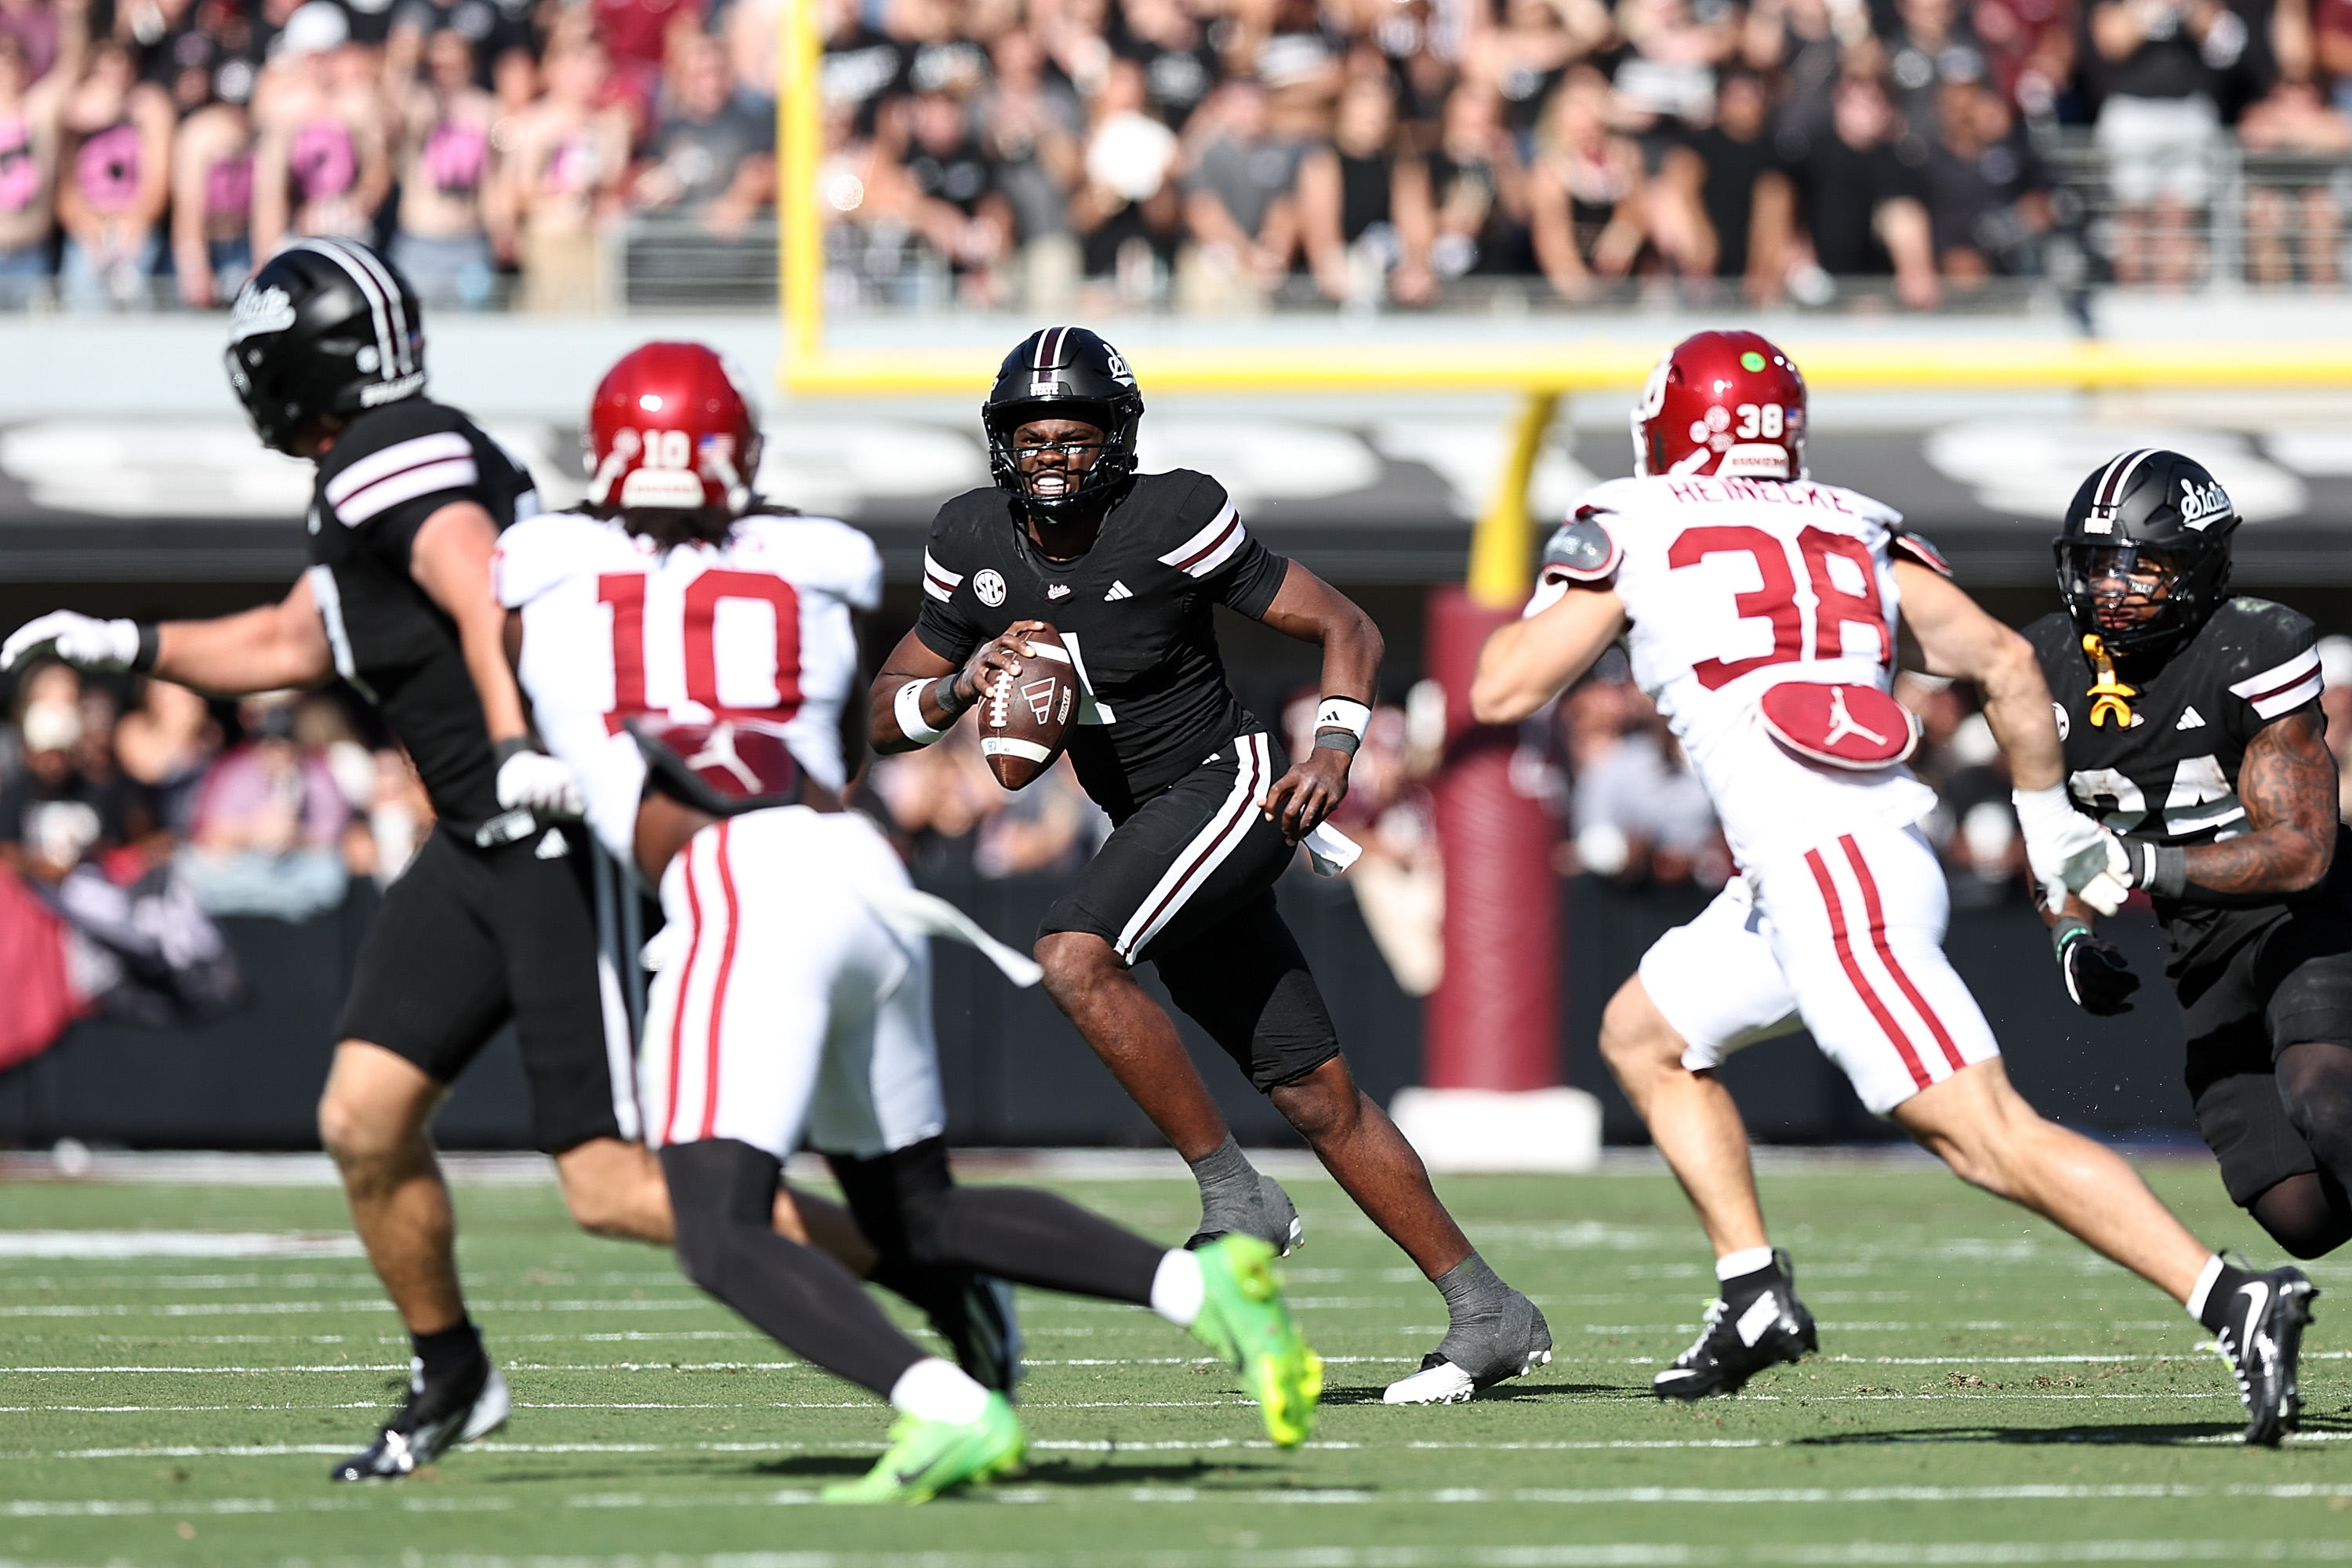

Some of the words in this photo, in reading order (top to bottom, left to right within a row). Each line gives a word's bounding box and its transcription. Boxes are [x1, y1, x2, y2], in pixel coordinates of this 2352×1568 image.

[1735, 403, 1784, 439] 38
[642, 429, 691, 469] 10
[1668, 475, 1854, 515] HEINECKE
[976, 572, 1004, 604] SEC
[1047, 584, 1071, 600] State
[1667, 524, 1893, 691] 38
[597, 569, 805, 737] 10
